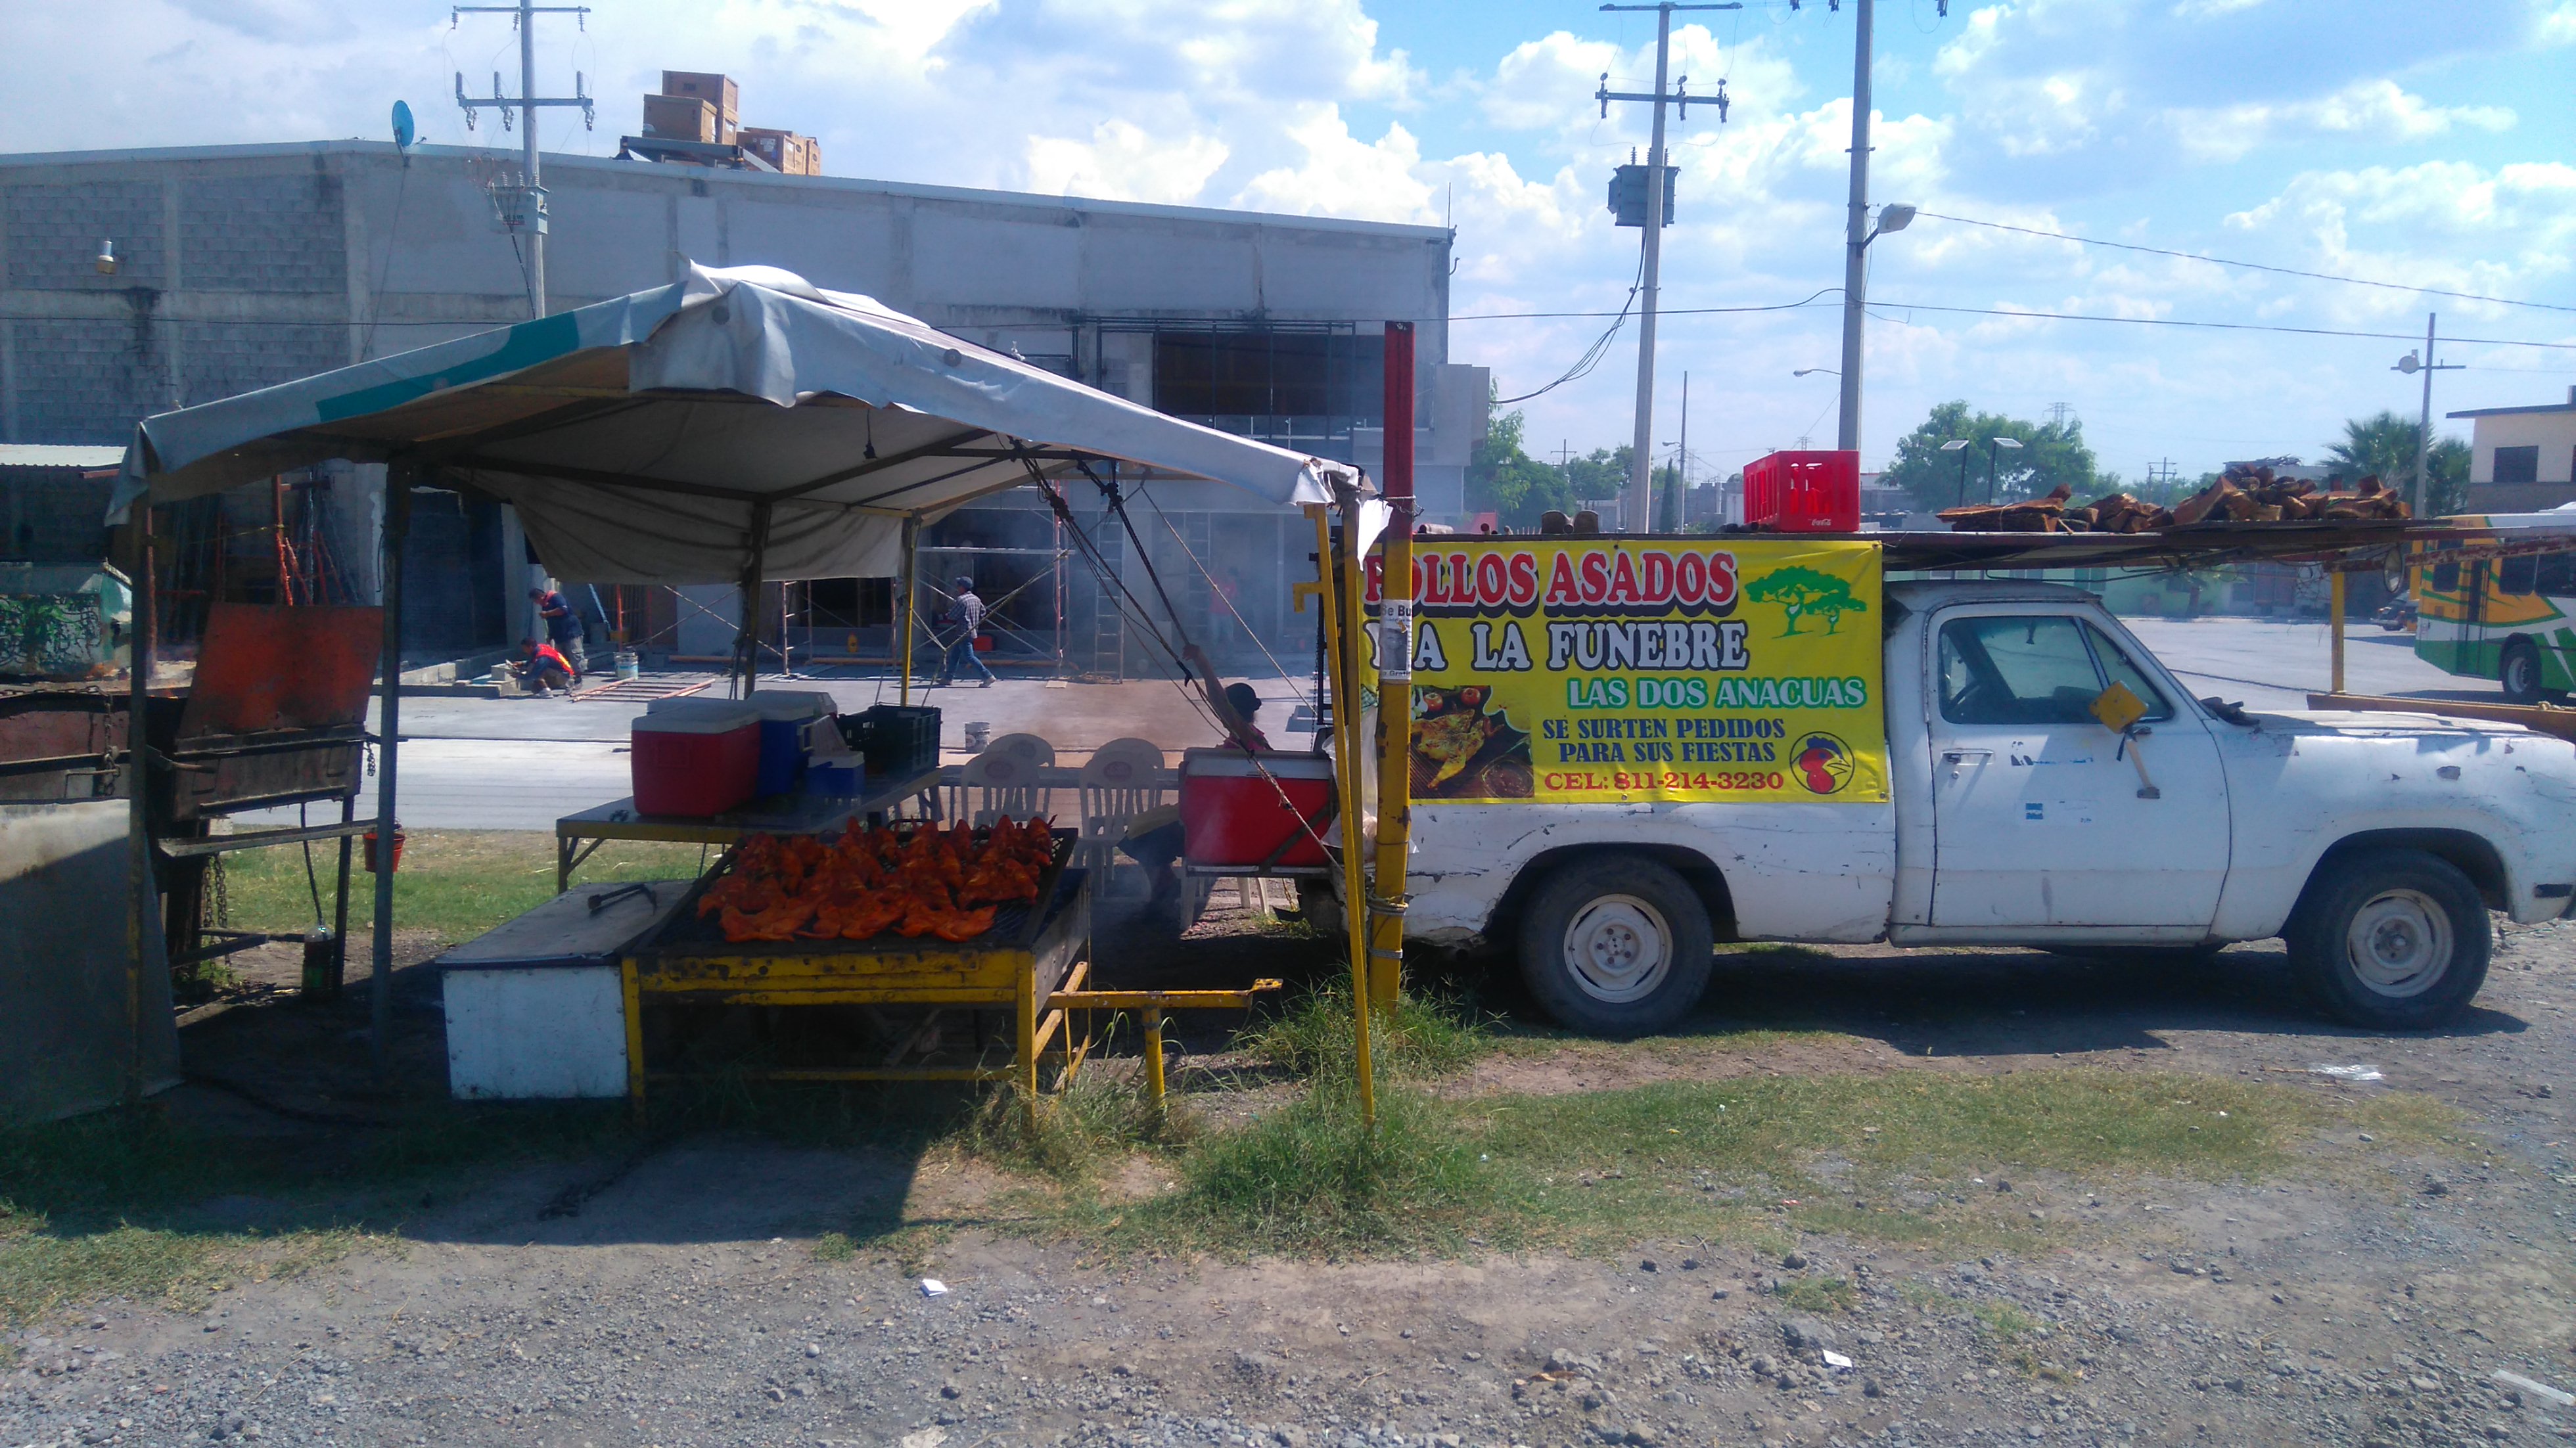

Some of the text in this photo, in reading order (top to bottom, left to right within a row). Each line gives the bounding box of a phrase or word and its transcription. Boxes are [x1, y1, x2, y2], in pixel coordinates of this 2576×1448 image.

[1363, 549, 1737, 608] PLLOS ASADOS
[1470, 621, 1533, 671] LA
[1546, 620, 1749, 671] FUNEBRE
[1567, 677, 1866, 709] LAS DOS ANACUAS
[1543, 718, 1785, 739] SE SURTEN PEDIDOS
[1559, 742, 1776, 762] PARA SUS FIESTAS
[1544, 771, 1784, 790] CEL: 811-214-3230
